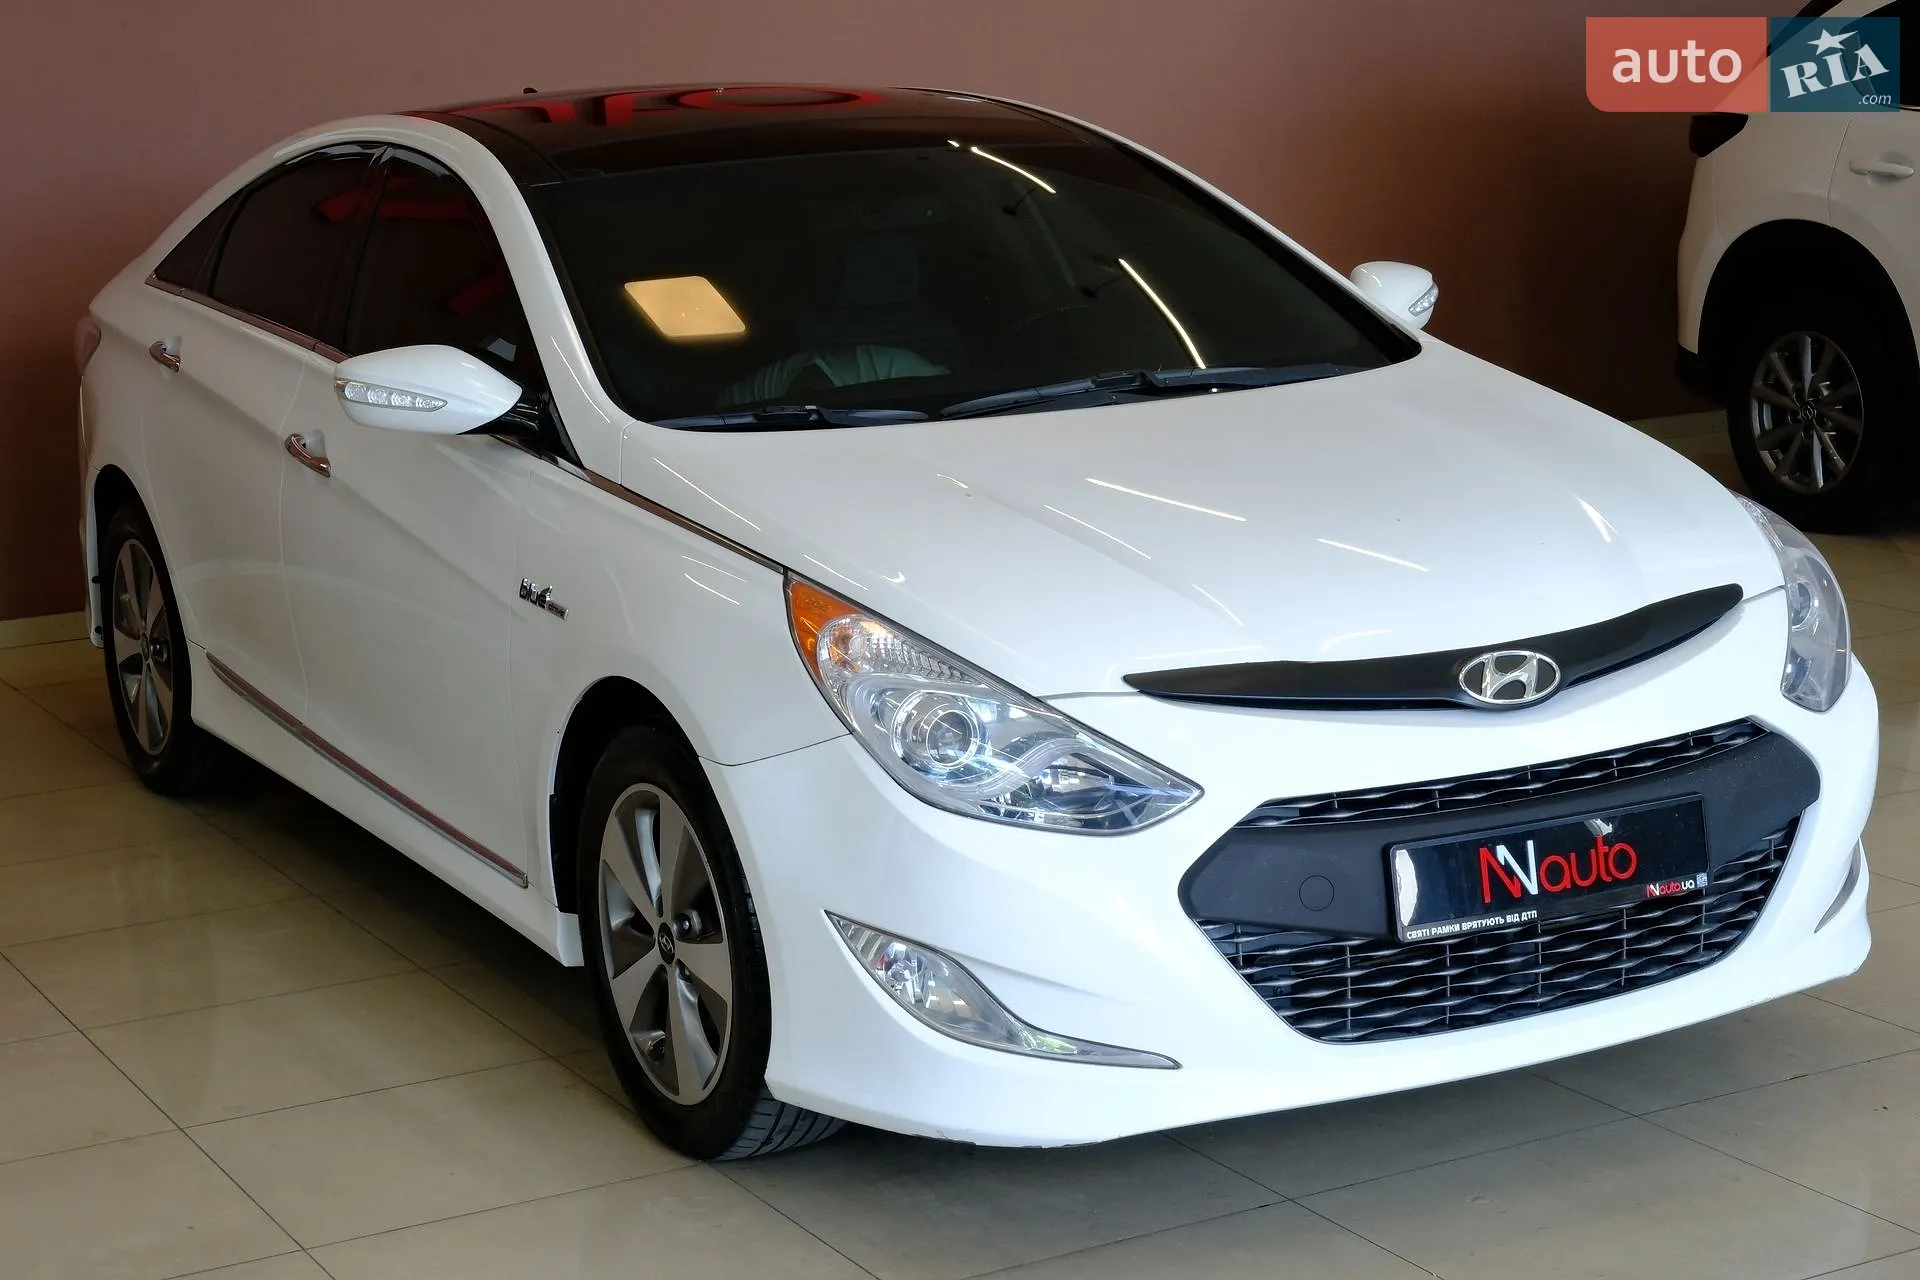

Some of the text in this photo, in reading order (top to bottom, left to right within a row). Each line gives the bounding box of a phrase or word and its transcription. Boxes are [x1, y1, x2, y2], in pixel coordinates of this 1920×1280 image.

[519, 577, 549, 609] blue
[1406, 910, 1538, 939] СВЯТІ РАМКИ ВРЯТУЮТЬ ВІД ДТП
